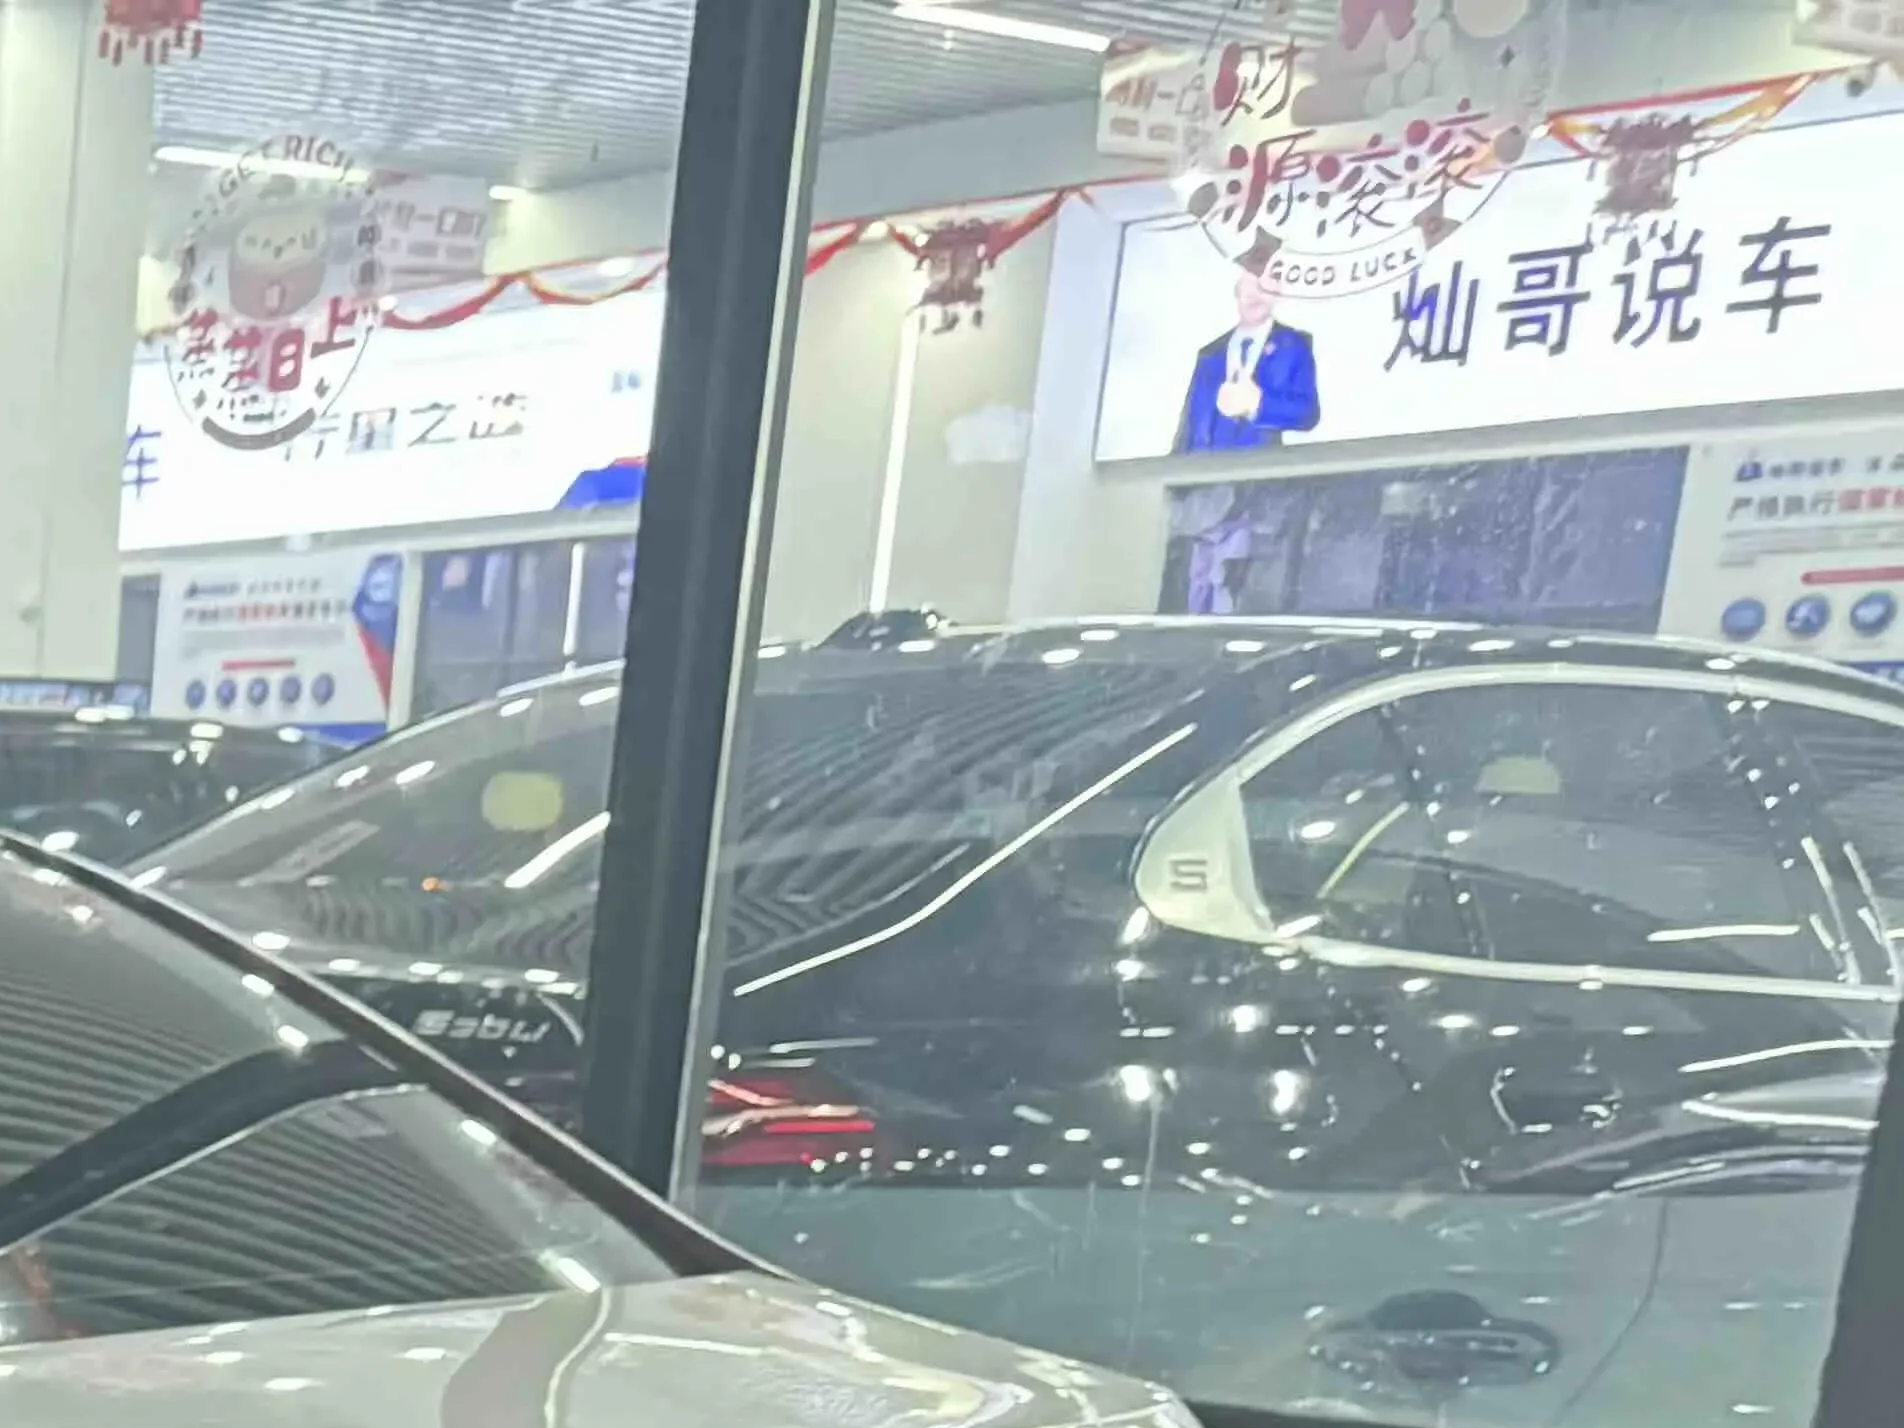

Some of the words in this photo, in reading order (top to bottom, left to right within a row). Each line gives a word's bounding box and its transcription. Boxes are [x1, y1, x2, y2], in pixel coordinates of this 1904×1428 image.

[1269, 259, 1336, 288] GOOD
[1350, 246, 1417, 283] LUCK
[1384, 216, 1833, 372] 灿哥说车
